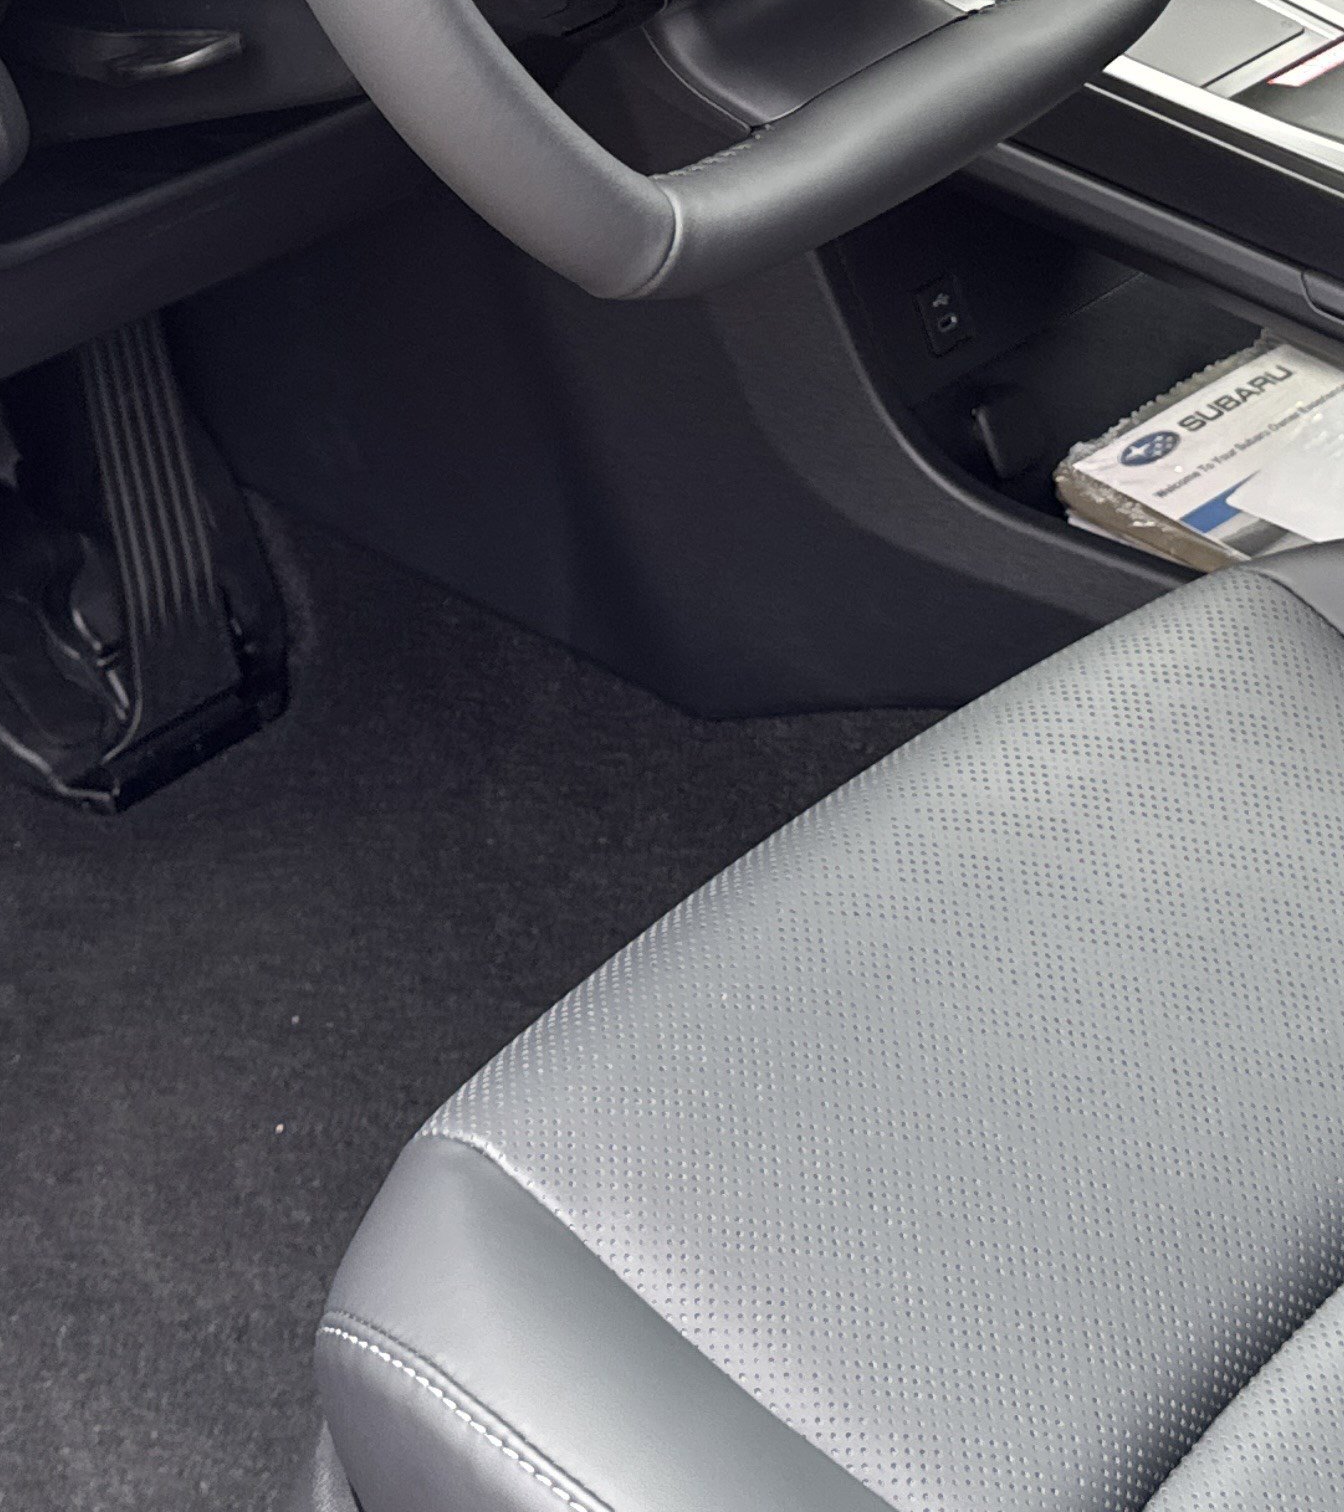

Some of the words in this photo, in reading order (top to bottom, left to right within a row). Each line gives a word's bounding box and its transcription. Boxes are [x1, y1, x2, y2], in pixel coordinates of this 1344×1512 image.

[1177, 364, 1294, 432] SUBARU
[1152, 470, 1202, 498] Welcome
[1197, 462, 1216, 473] To
[1211, 448, 1237, 464] Your
[1233, 428, 1272, 451] Subaru
